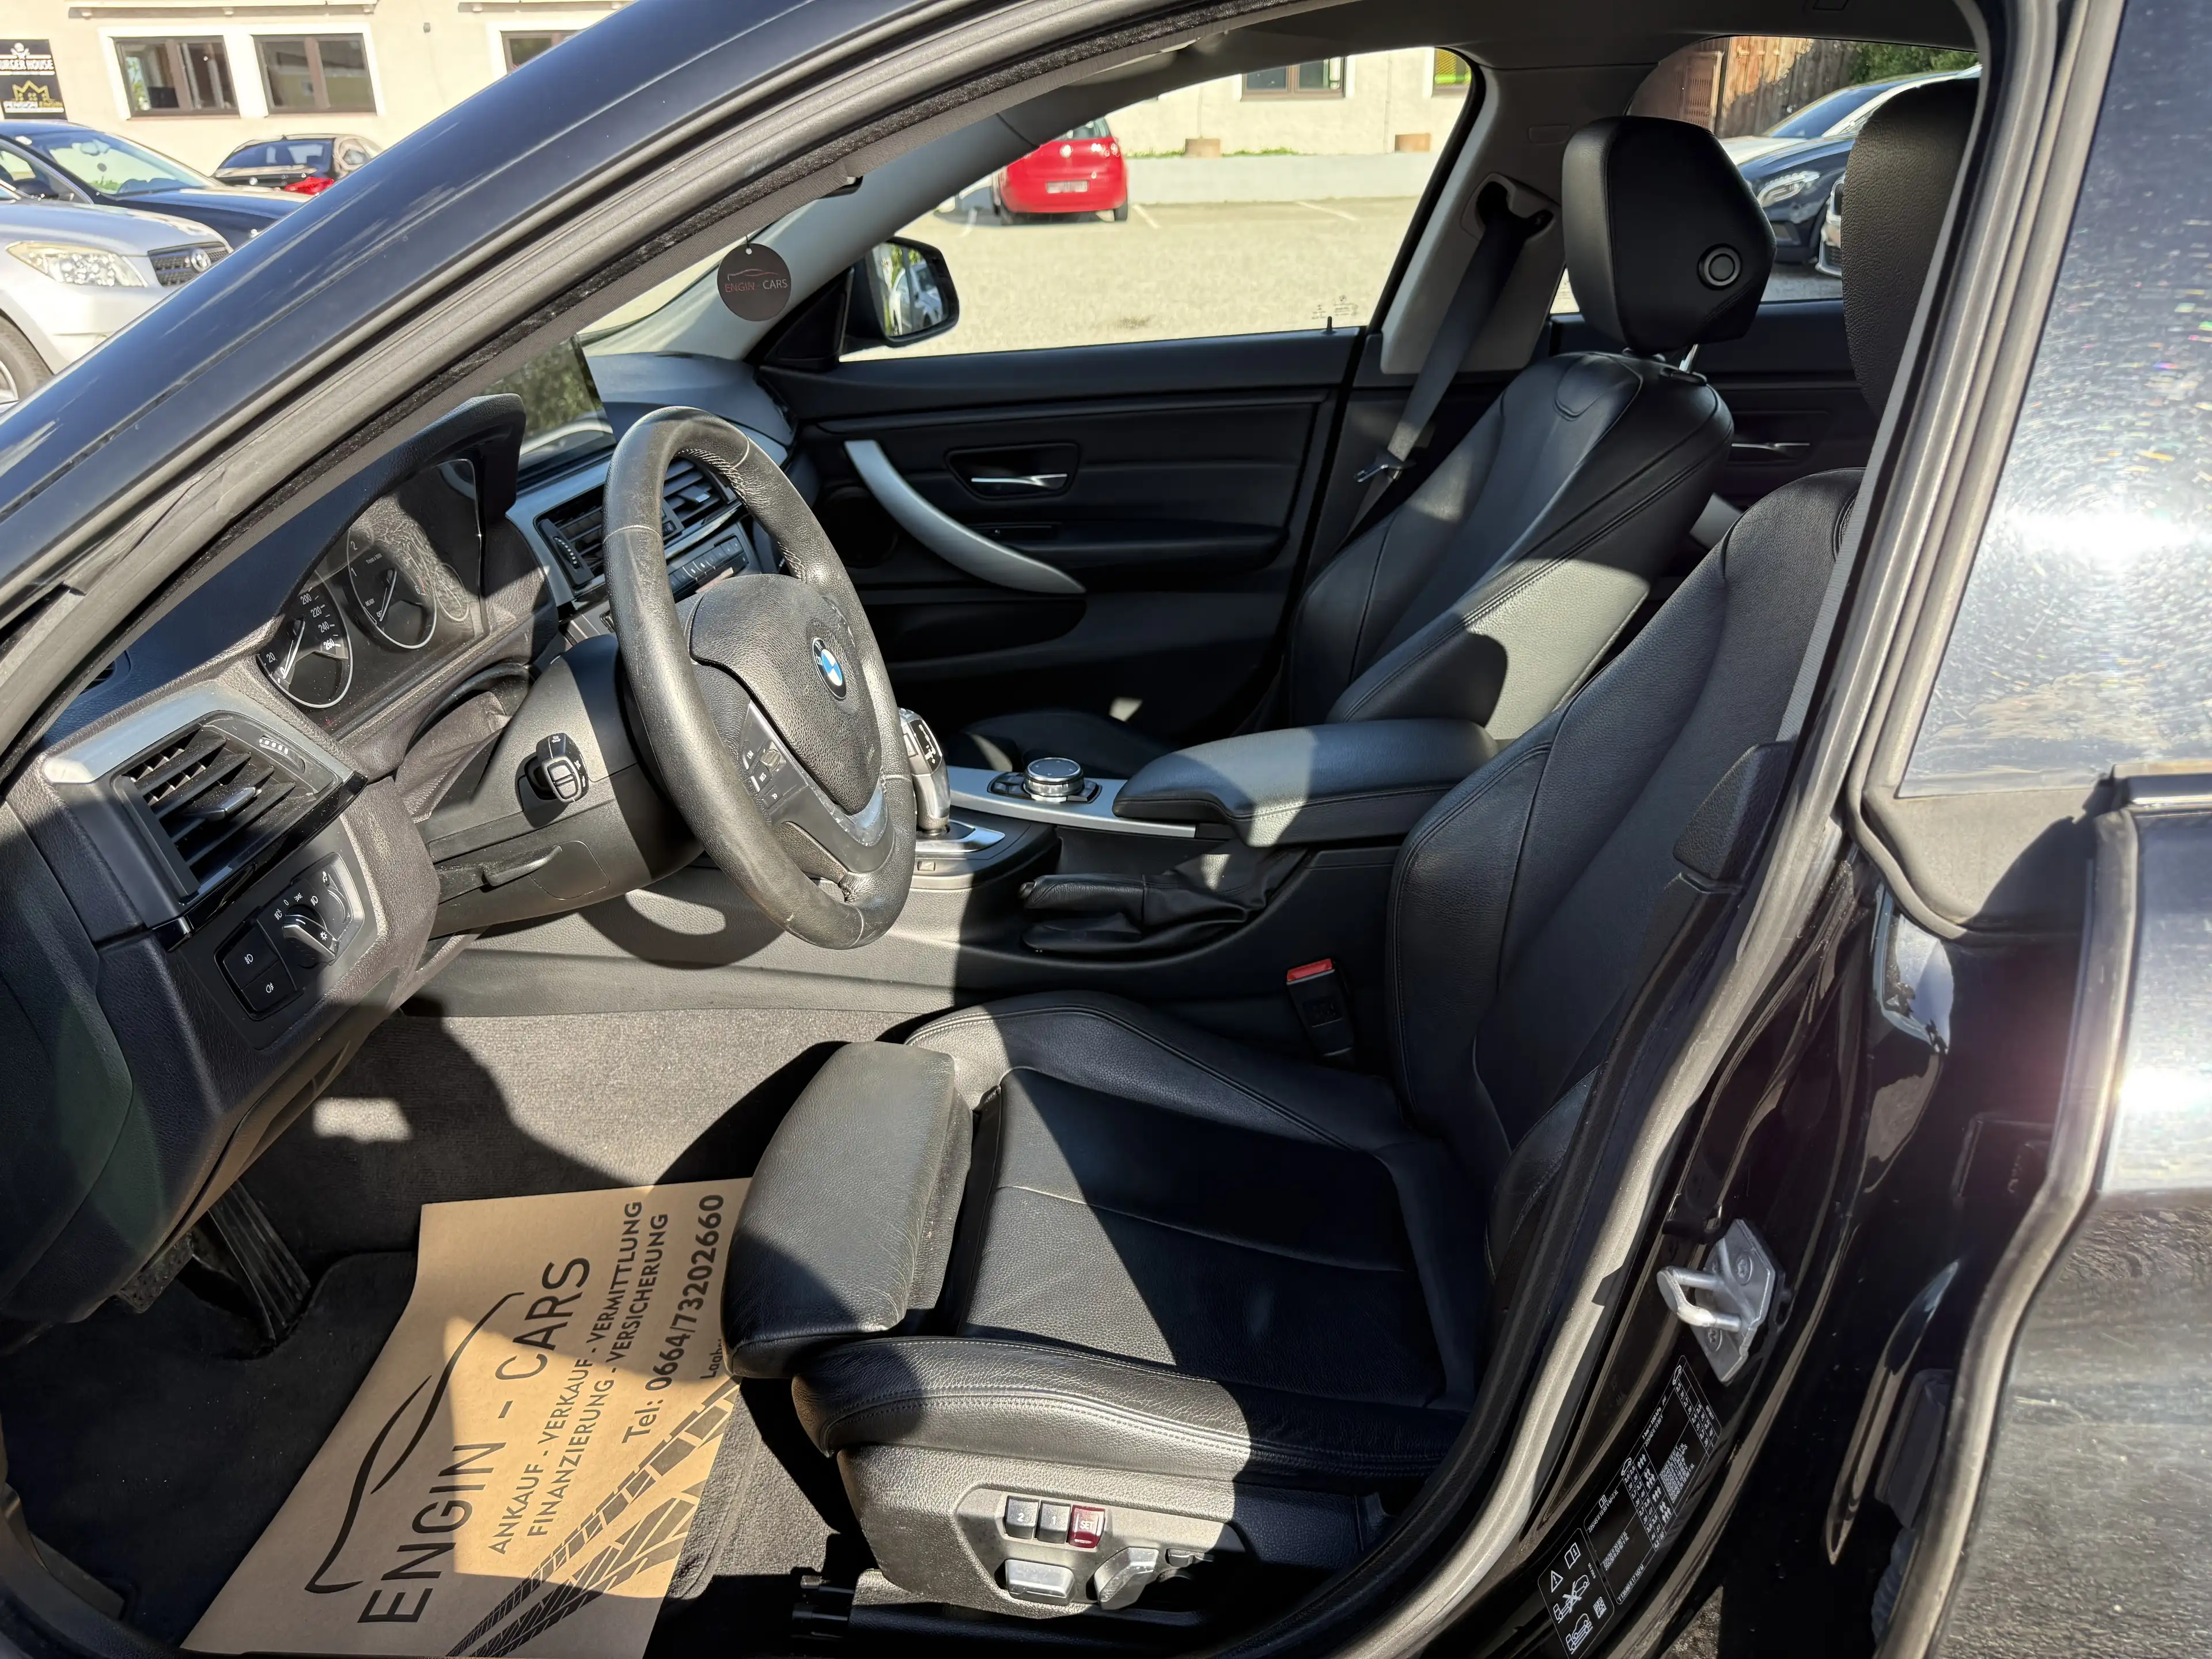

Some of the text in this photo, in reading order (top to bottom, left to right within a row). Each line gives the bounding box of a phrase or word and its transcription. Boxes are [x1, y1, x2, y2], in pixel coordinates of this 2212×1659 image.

[725, 279, 788, 293] ENGIN CARS
[350, 541, 358, 551] 2
[351, 567, 357, 577] 1
[300, 593, 312, 605] 200
[310, 606, 322, 618] 220
[318, 621, 329, 633] 240
[323, 638, 335, 650] 260
[266, 652, 276, 663] 20
[622, 1194, 724, 1444] Tel: 0664/73202660
[487, 1464, 544, 1555] ANKAUF
[537, 1359, 593, 1444] VERKAUF
[586, 1202, 642, 1343] VERMITTLUNG
[527, 1380, 614, 1536] FINANZIERUNG
[605, 1214, 668, 1362] VERSICHERUNG
[357, 1441, 506, 1623] ENGIN
[495, 1257, 590, 1381] CARS
[1017, 1512, 1094, 1531] 2 1 SET
